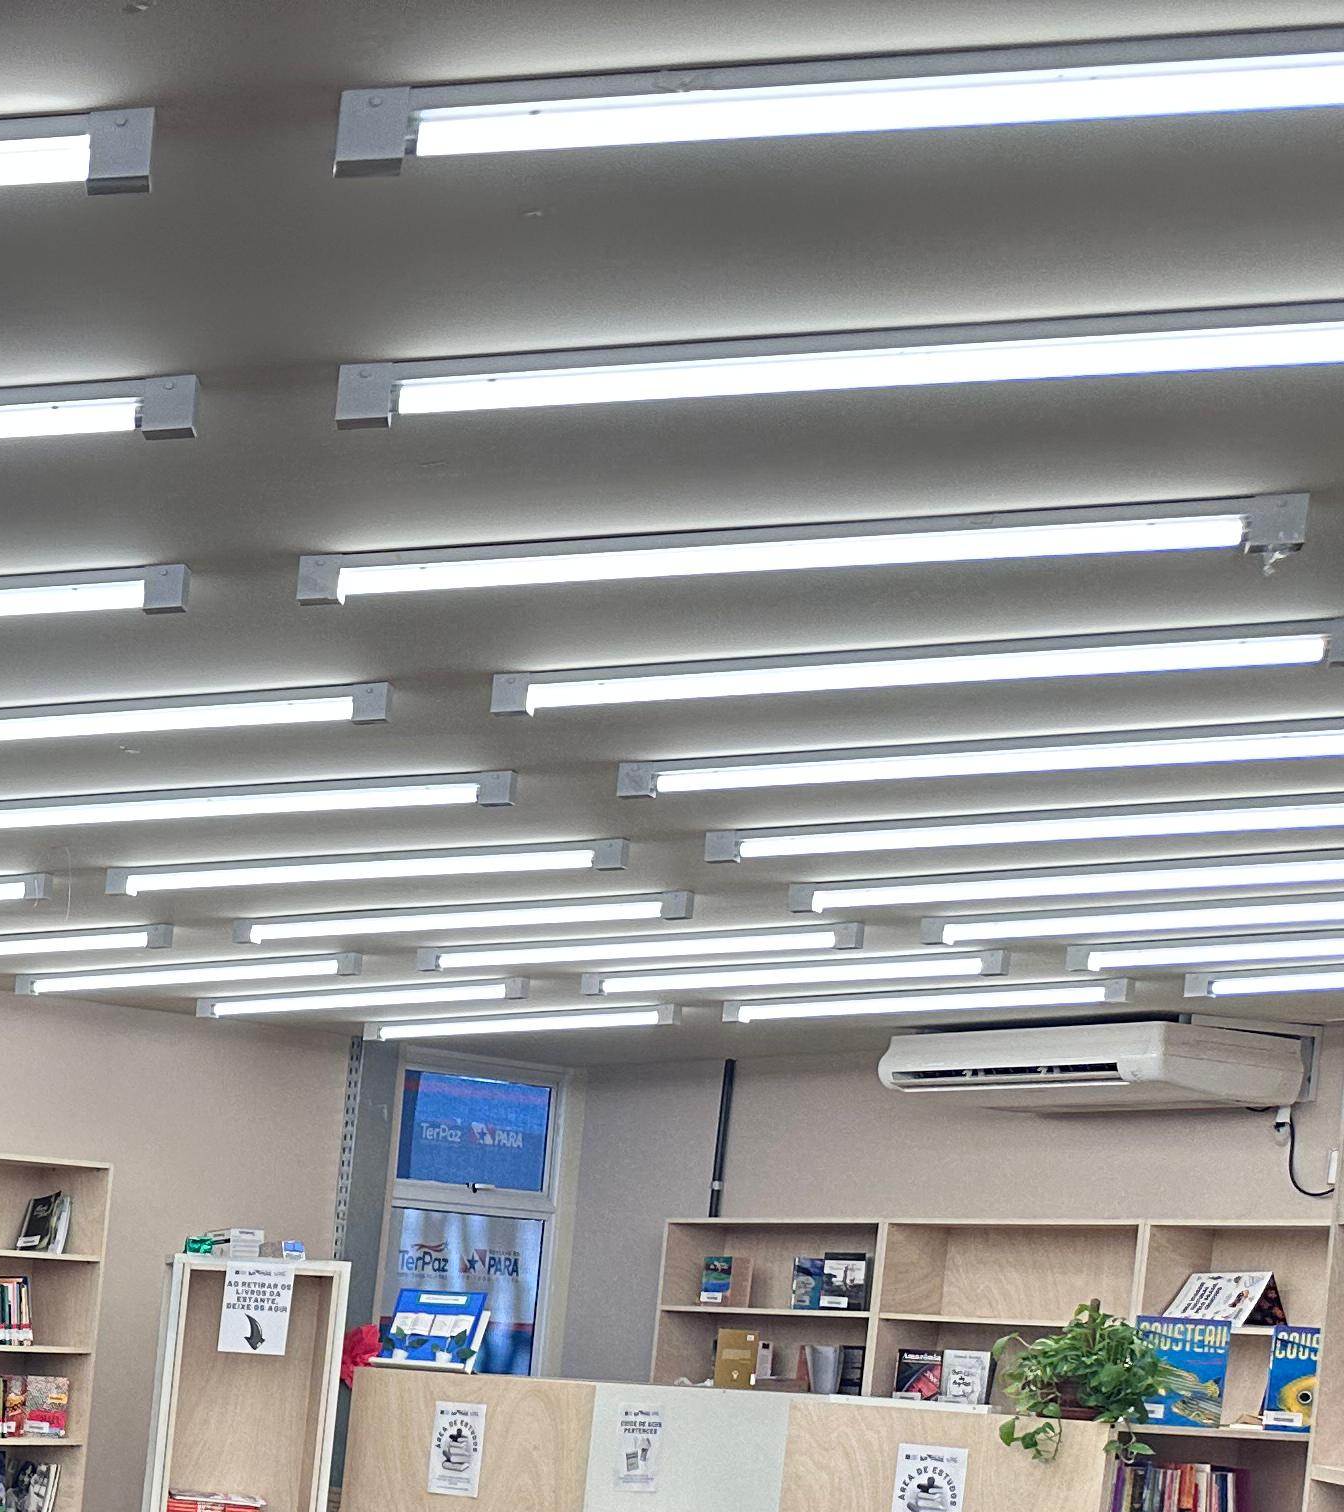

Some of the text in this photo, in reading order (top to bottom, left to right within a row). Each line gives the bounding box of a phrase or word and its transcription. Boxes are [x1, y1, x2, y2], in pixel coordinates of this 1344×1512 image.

[421, 1122, 462, 1142] TerPaz
[398, 1249, 449, 1273] TerPaz
[235, 1288, 266, 1297] LIVROS
[241, 1281, 278, 1290] RETIRAR
[280, 1283, 292, 1291] OS
[226, 1302, 252, 1311] DEIXE
[931, 1466, 957, 1507] ESTUDOS
